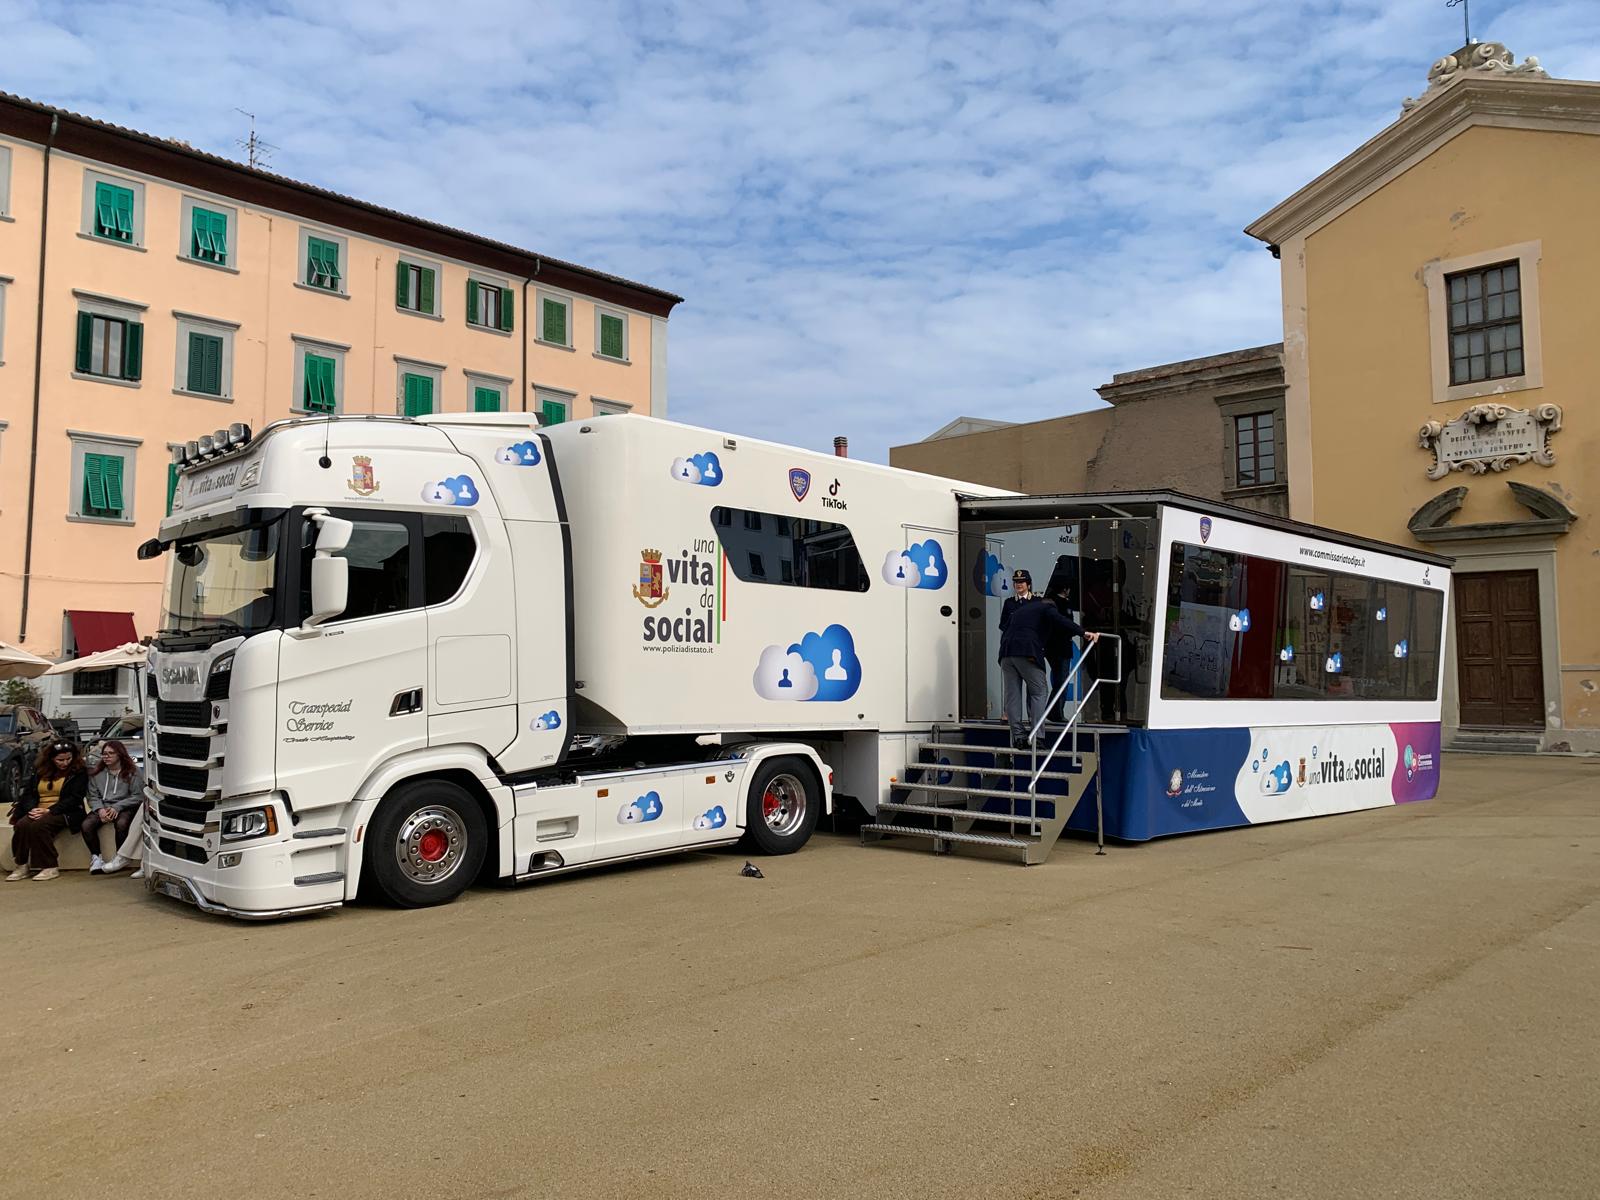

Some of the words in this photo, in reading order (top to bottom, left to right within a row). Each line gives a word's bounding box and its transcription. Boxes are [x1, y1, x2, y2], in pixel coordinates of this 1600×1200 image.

[199, 475, 212, 494] vita
[215, 466, 239, 489] social
[821, 496, 848, 510] TikTok
[693, 538, 715, 553] una
[1299, 547, 1366, 568] www.commissariatodips.it
[666, 549, 714, 586] vita
[700, 587, 714, 608] da
[643, 607, 713, 643] social
[642, 644, 714, 654] www.poliziadistato.it
[162, 666, 201, 684] SCANIA
[288, 699, 353, 717] Transpecial
[286, 718, 335, 732] Service
[1320, 751, 1344, 783] vita
[1345, 762, 1354, 781] da
[1354, 747, 1385, 780] social
